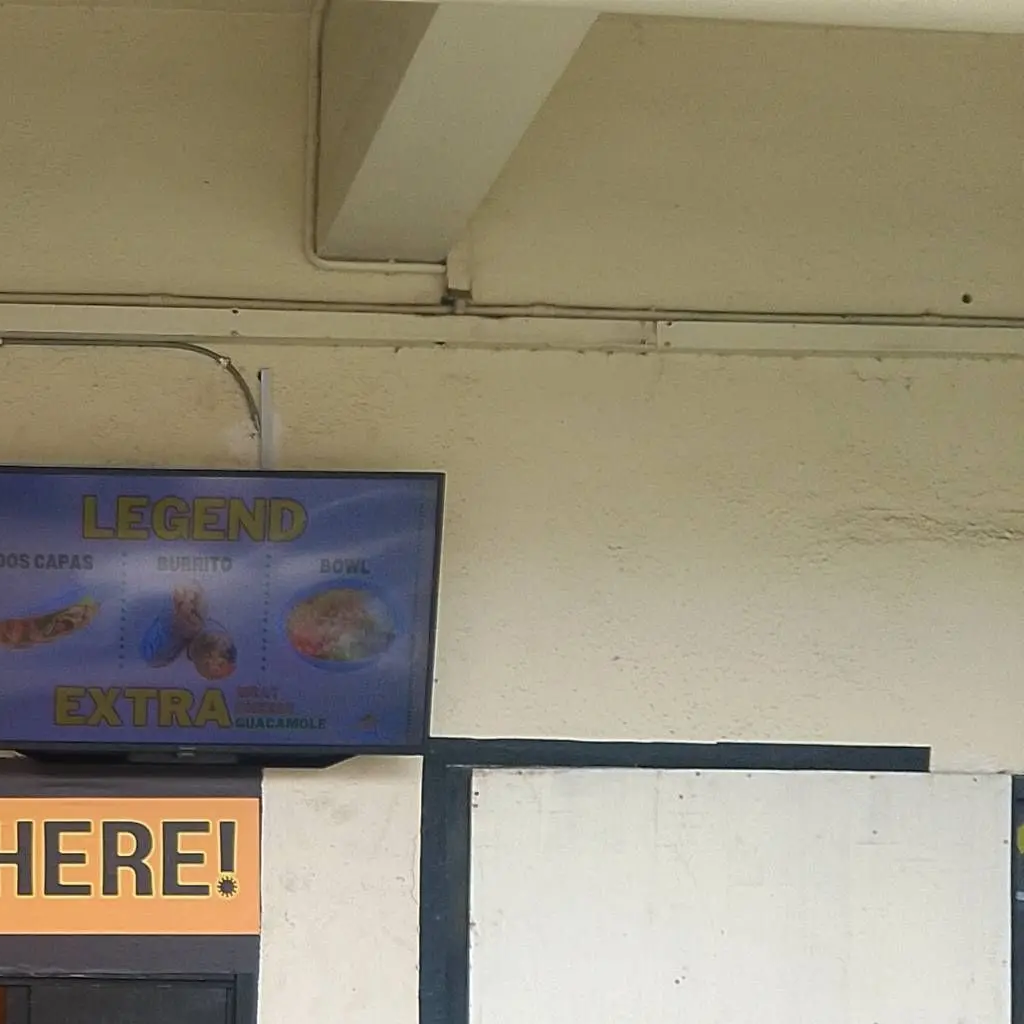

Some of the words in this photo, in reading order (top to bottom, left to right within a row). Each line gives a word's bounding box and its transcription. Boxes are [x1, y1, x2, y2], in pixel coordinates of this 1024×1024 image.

[82, 494, 308, 542] LEGEND
[33, 553, 94, 571] CAPAS
[157, 556, 233, 573] BURRITO
[320, 558, 371, 575] BOWL
[54, 685, 233, 728] EXTRA
[234, 716, 327, 730] GUACAMOLE
